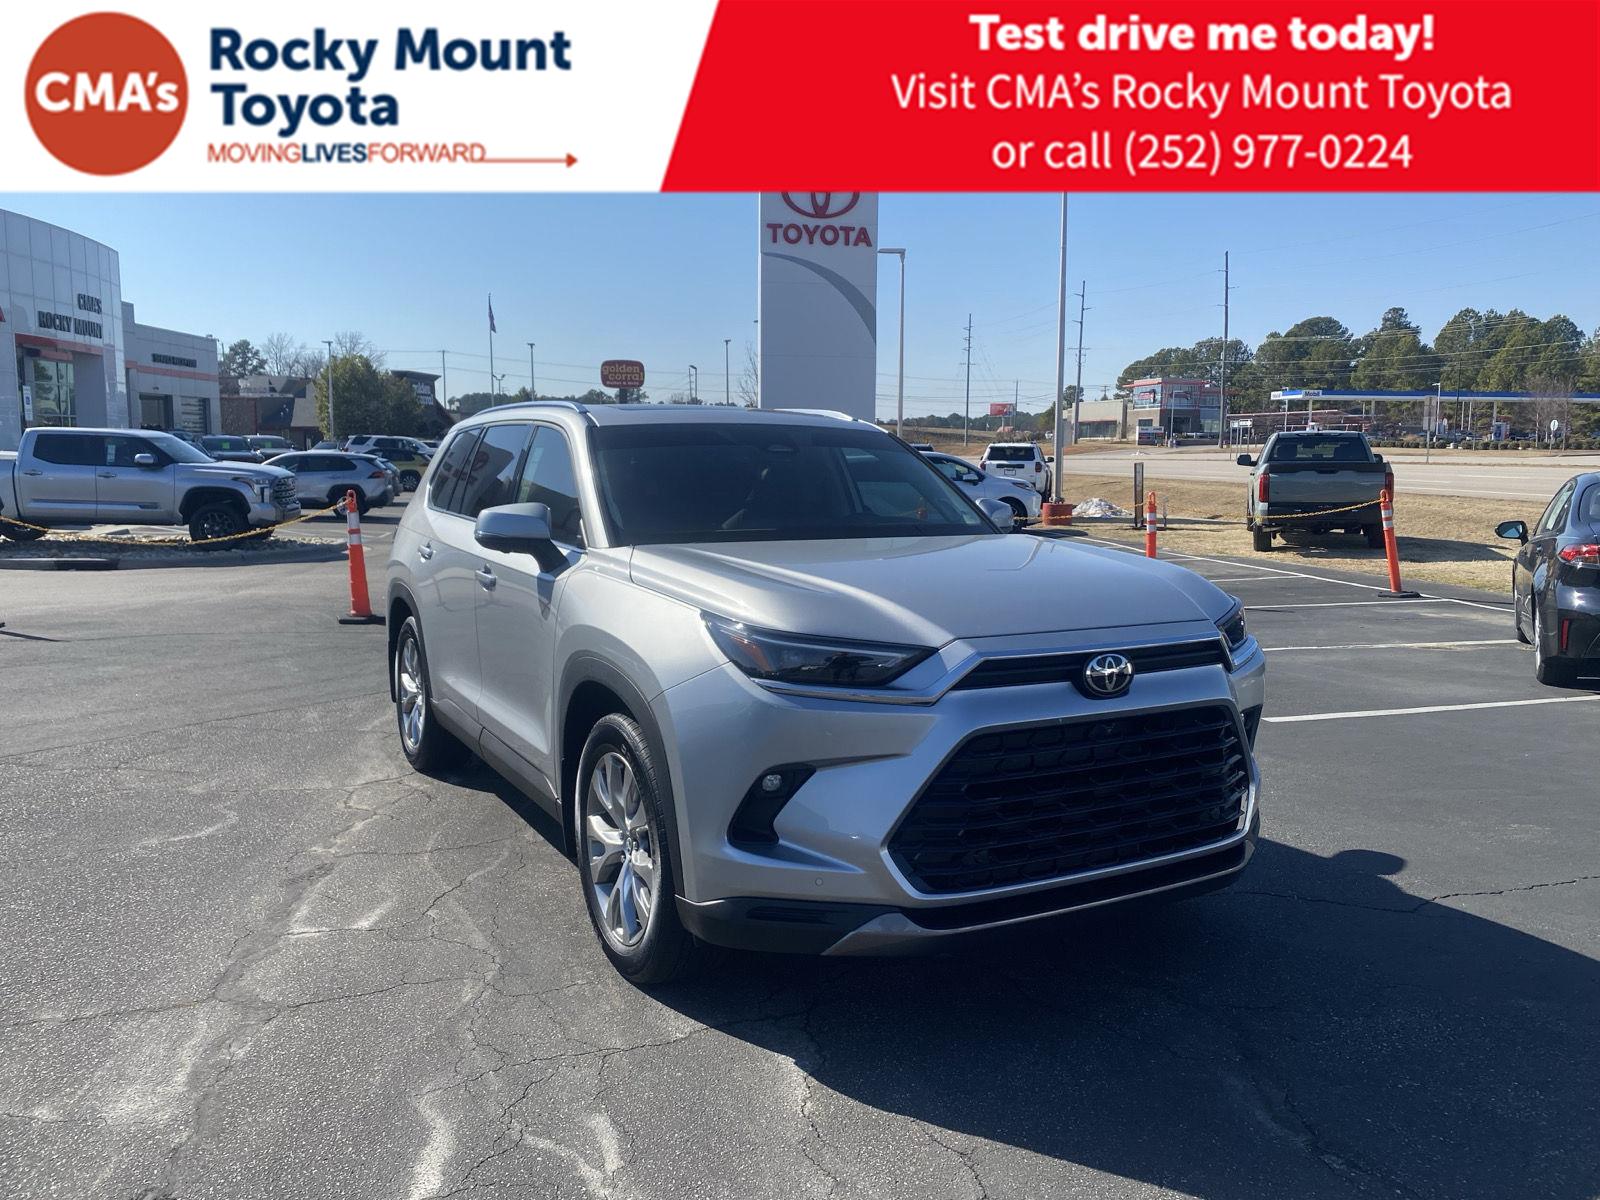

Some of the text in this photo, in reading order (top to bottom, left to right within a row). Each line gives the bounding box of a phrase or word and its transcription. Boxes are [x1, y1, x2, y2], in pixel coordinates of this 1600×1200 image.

[766, 223, 873, 247] TOYOTA
[38, 311, 103, 339] ROCKY MOUNT
[602, 364, 640, 375] golden
[608, 371, 644, 381] corral
